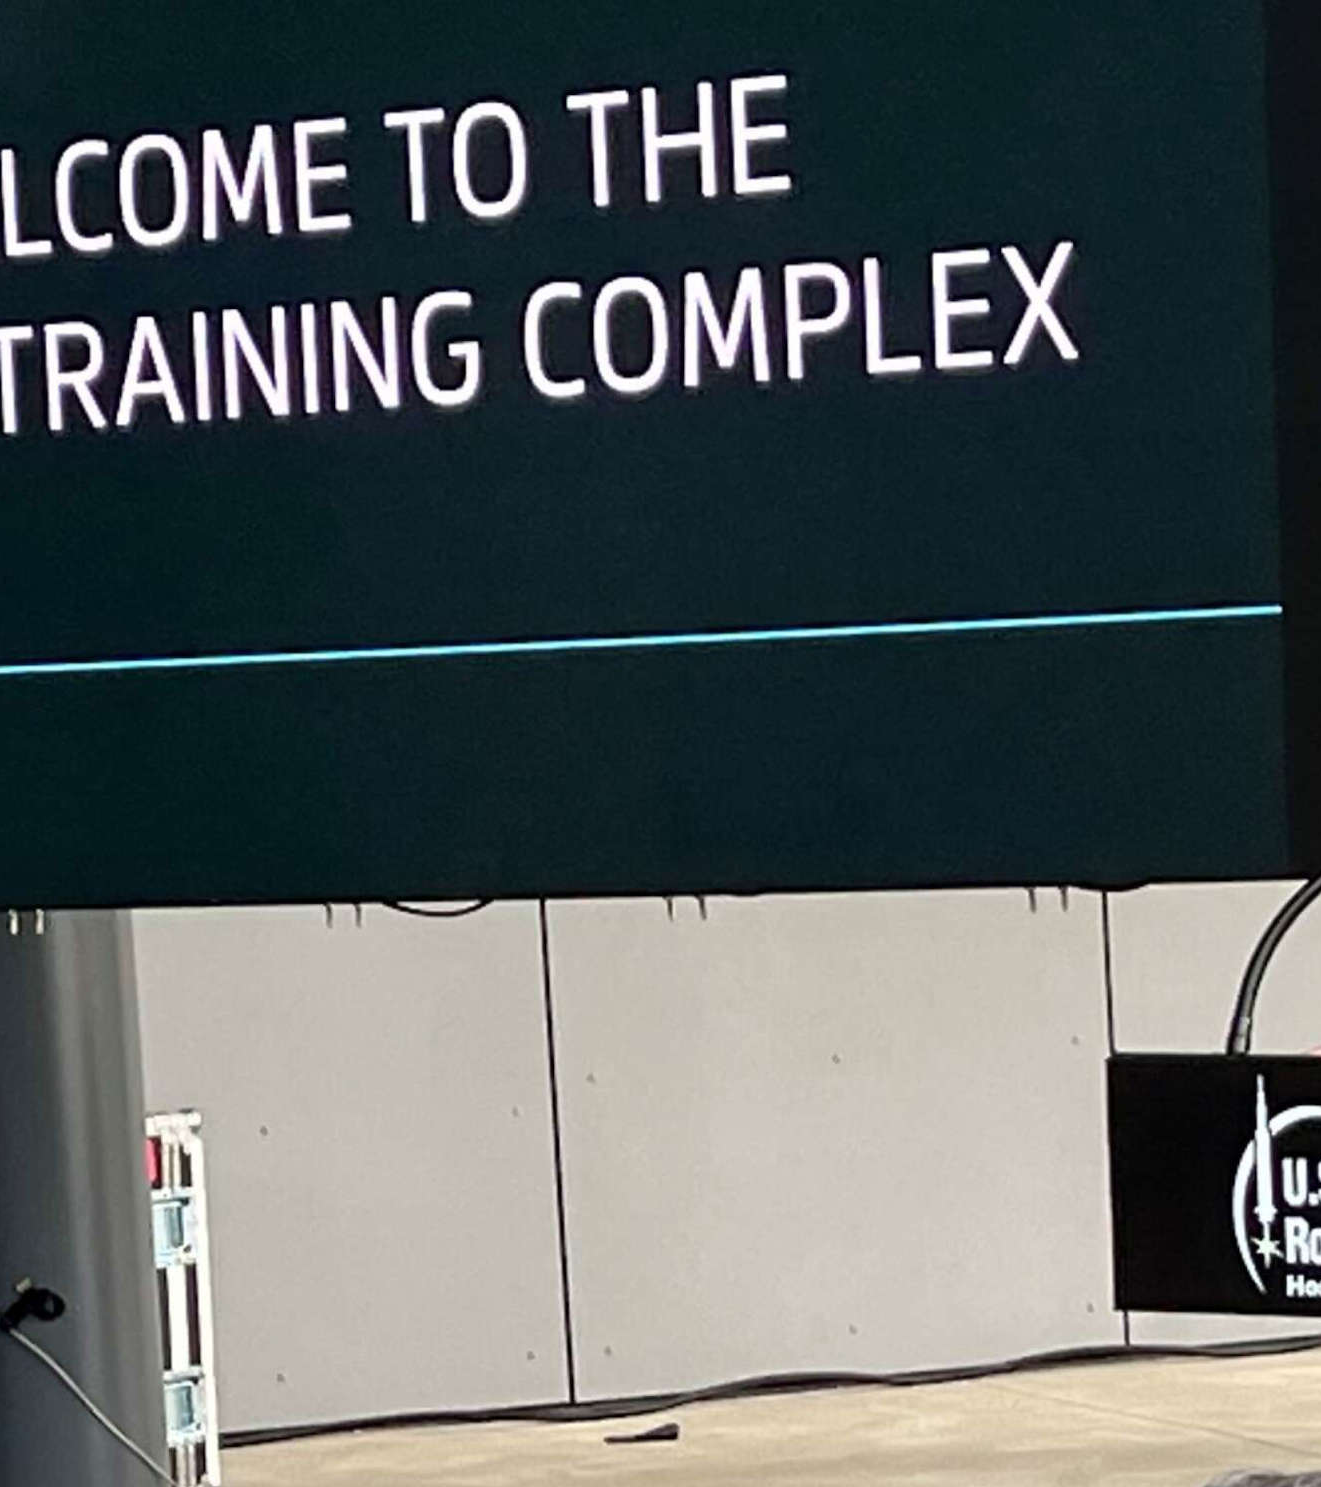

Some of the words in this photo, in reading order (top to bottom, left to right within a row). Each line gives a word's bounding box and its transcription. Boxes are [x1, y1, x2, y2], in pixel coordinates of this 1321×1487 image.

[383, 101, 527, 223] TO
[566, 74, 793, 209] THE
[524, 241, 1080, 400] COMPLEX
